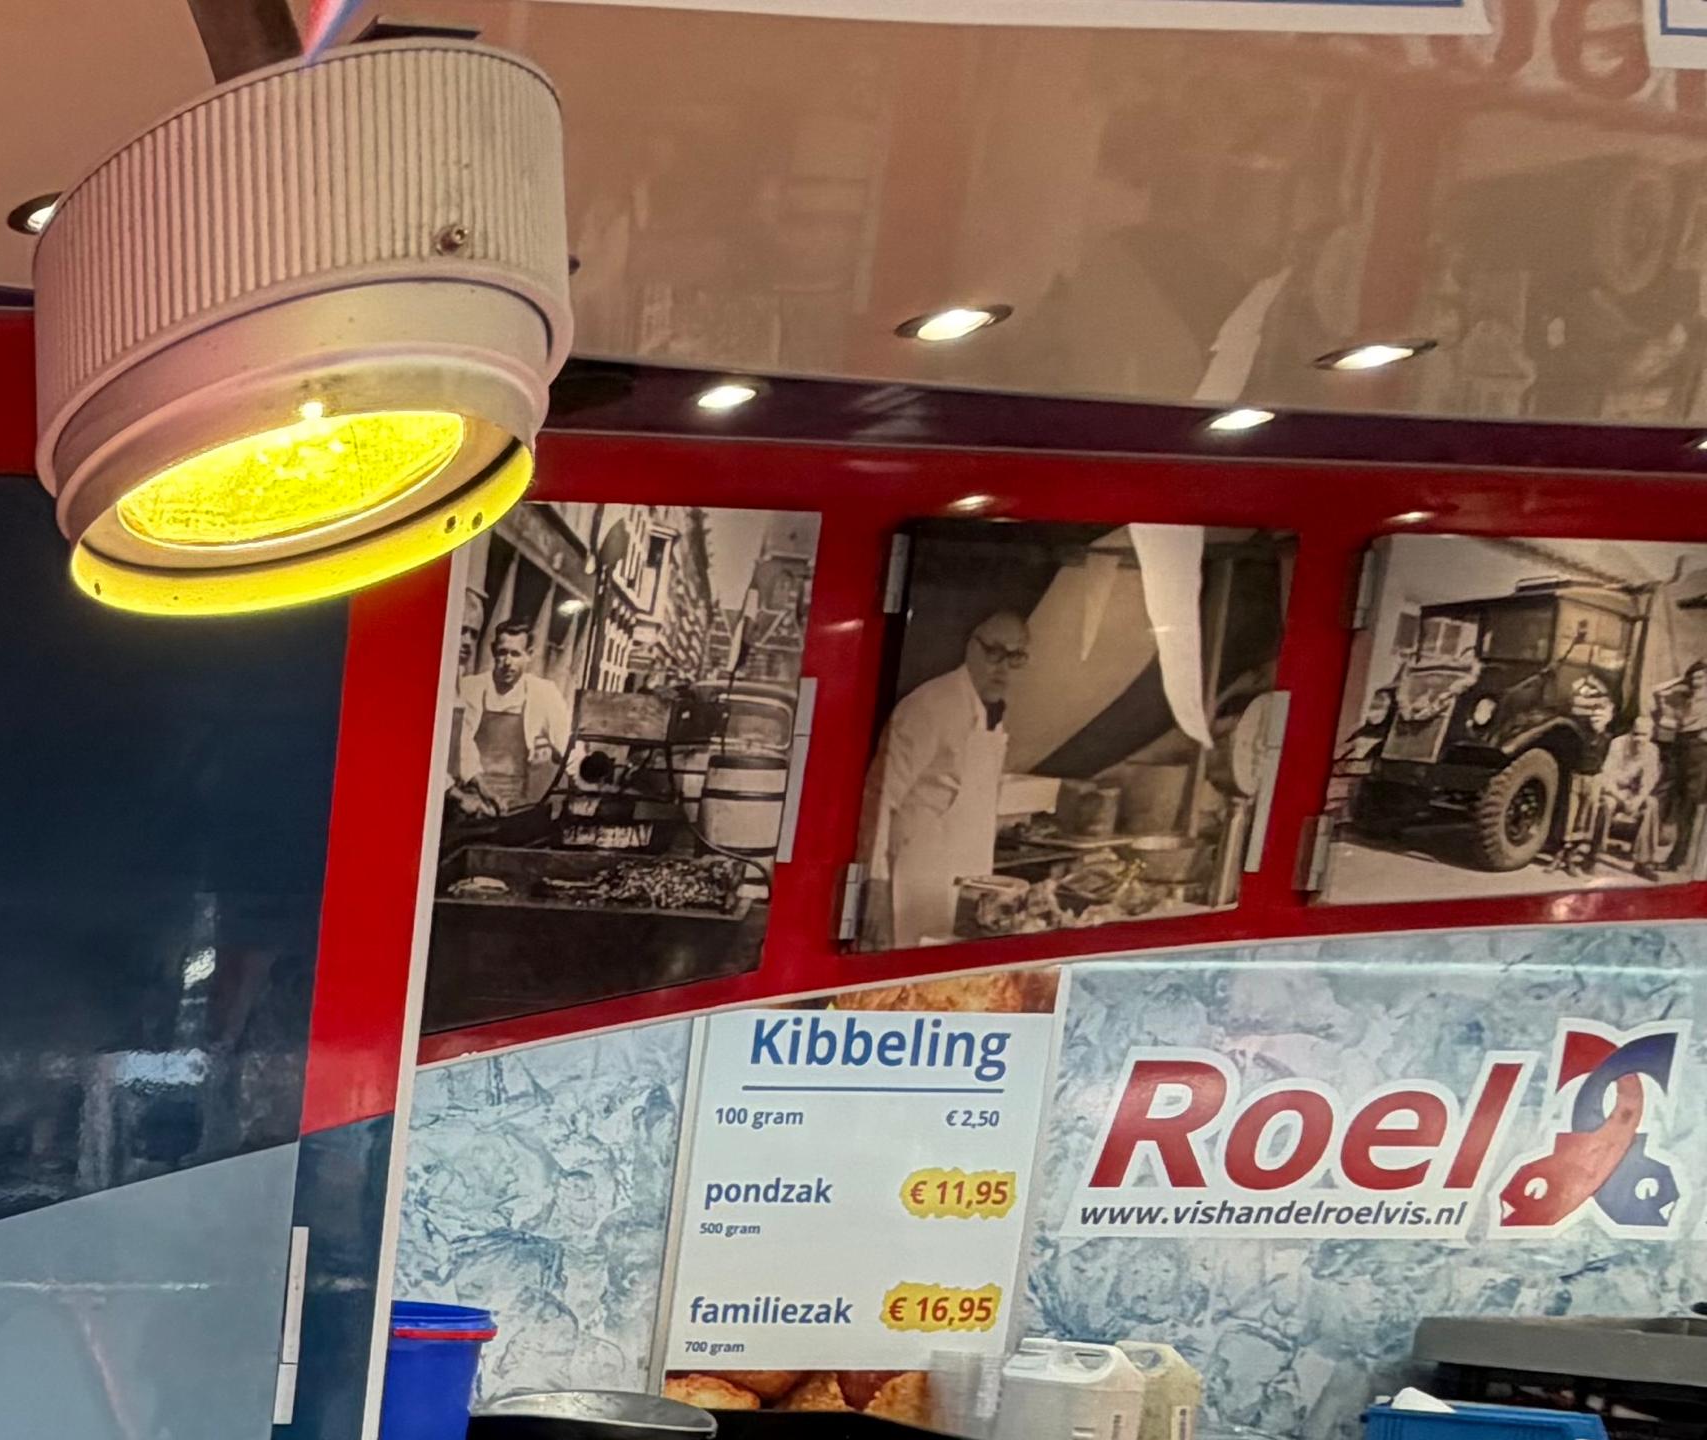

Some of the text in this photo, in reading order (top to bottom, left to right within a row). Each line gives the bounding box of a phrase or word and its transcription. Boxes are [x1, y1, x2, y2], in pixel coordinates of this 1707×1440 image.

[750, 1017, 1011, 1082] Kibbeling
[715, 1108, 804, 1129] 100 gram
[961, 1110, 1000, 1128] 2,50
[1087, 1060, 1524, 1191] Roel
[704, 1177, 832, 1209] pondzak
[910, 1181, 1009, 1208] € 11,95
[1080, 1199, 1468, 1226] www.vishandelroelvis.nl
[700, 1223, 760, 1237] 500 gram
[690, 1296, 854, 1324] familiezak
[889, 1297, 993, 1325] € 16,95
[685, 1341, 744, 1355] 700 gram
